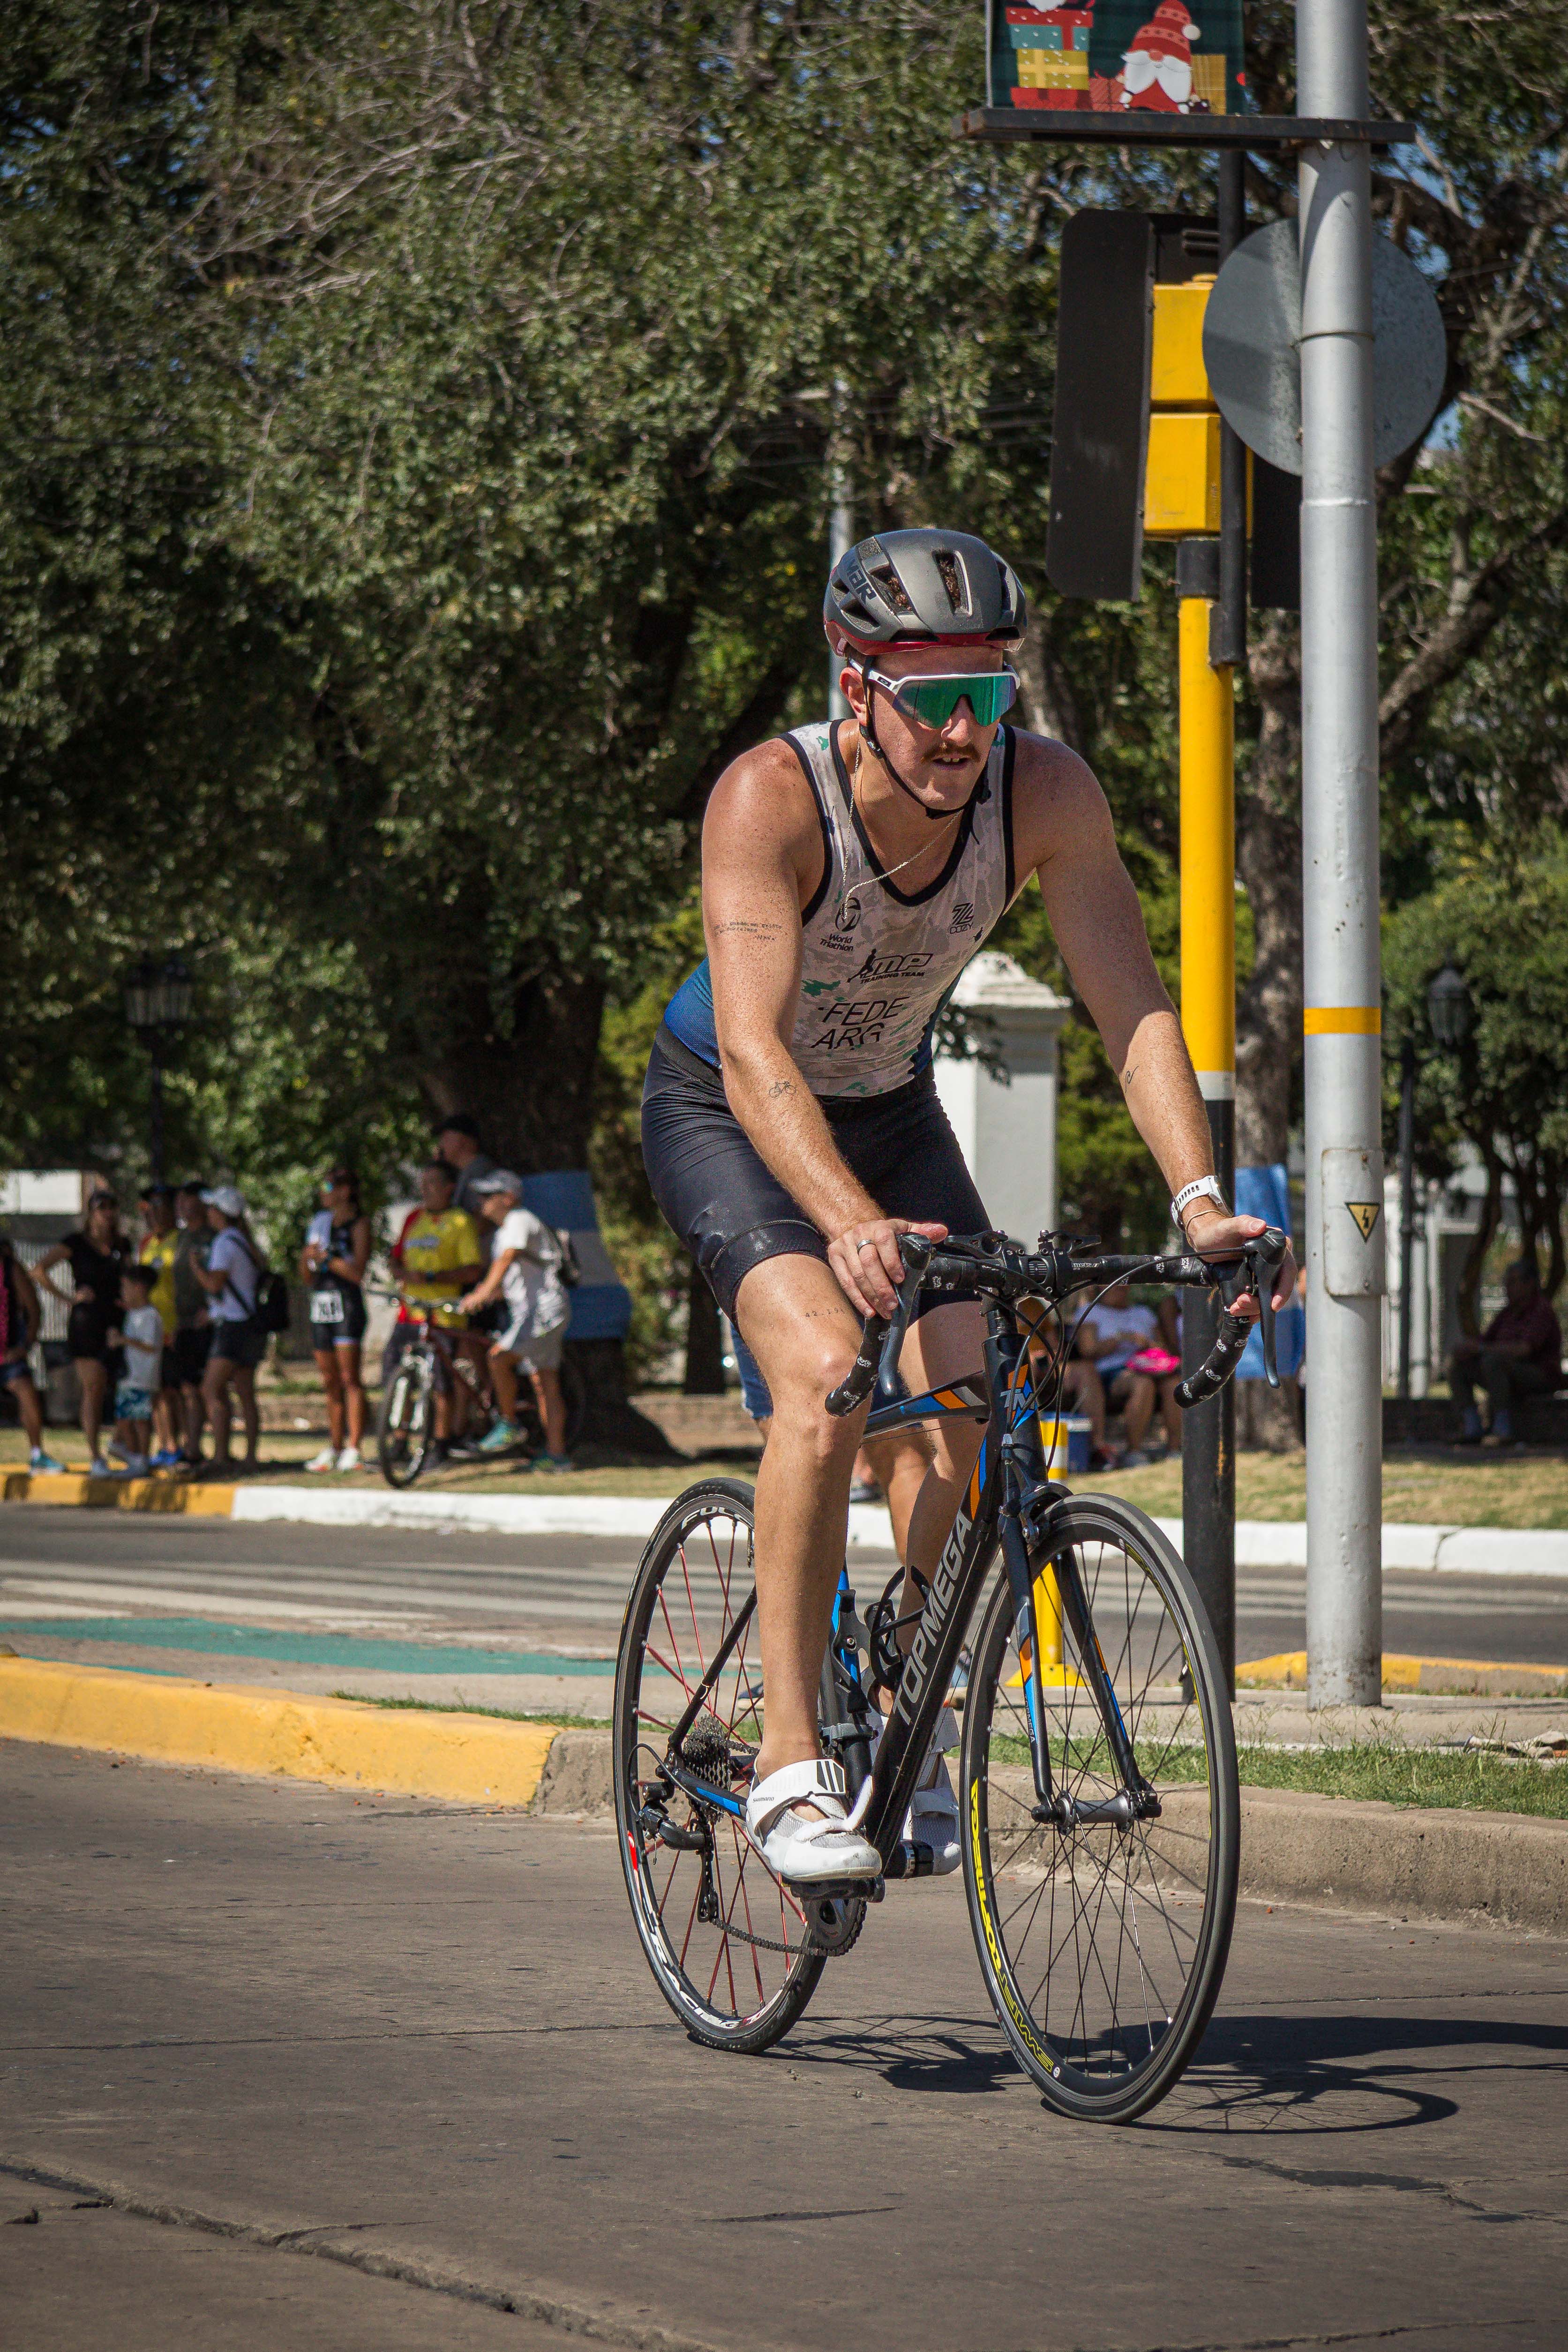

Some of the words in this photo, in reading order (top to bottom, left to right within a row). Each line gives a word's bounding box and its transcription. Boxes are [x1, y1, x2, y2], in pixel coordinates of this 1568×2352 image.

[819, 938, 854, 951] Triathlon
[829, 933, 854, 944] World
[861, 973, 899, 984] TRAINING
[822, 996, 911, 1026] FEDE
[810, 1022, 885, 1049] ARG
[893, 1508, 972, 1726] TOPMEGA
